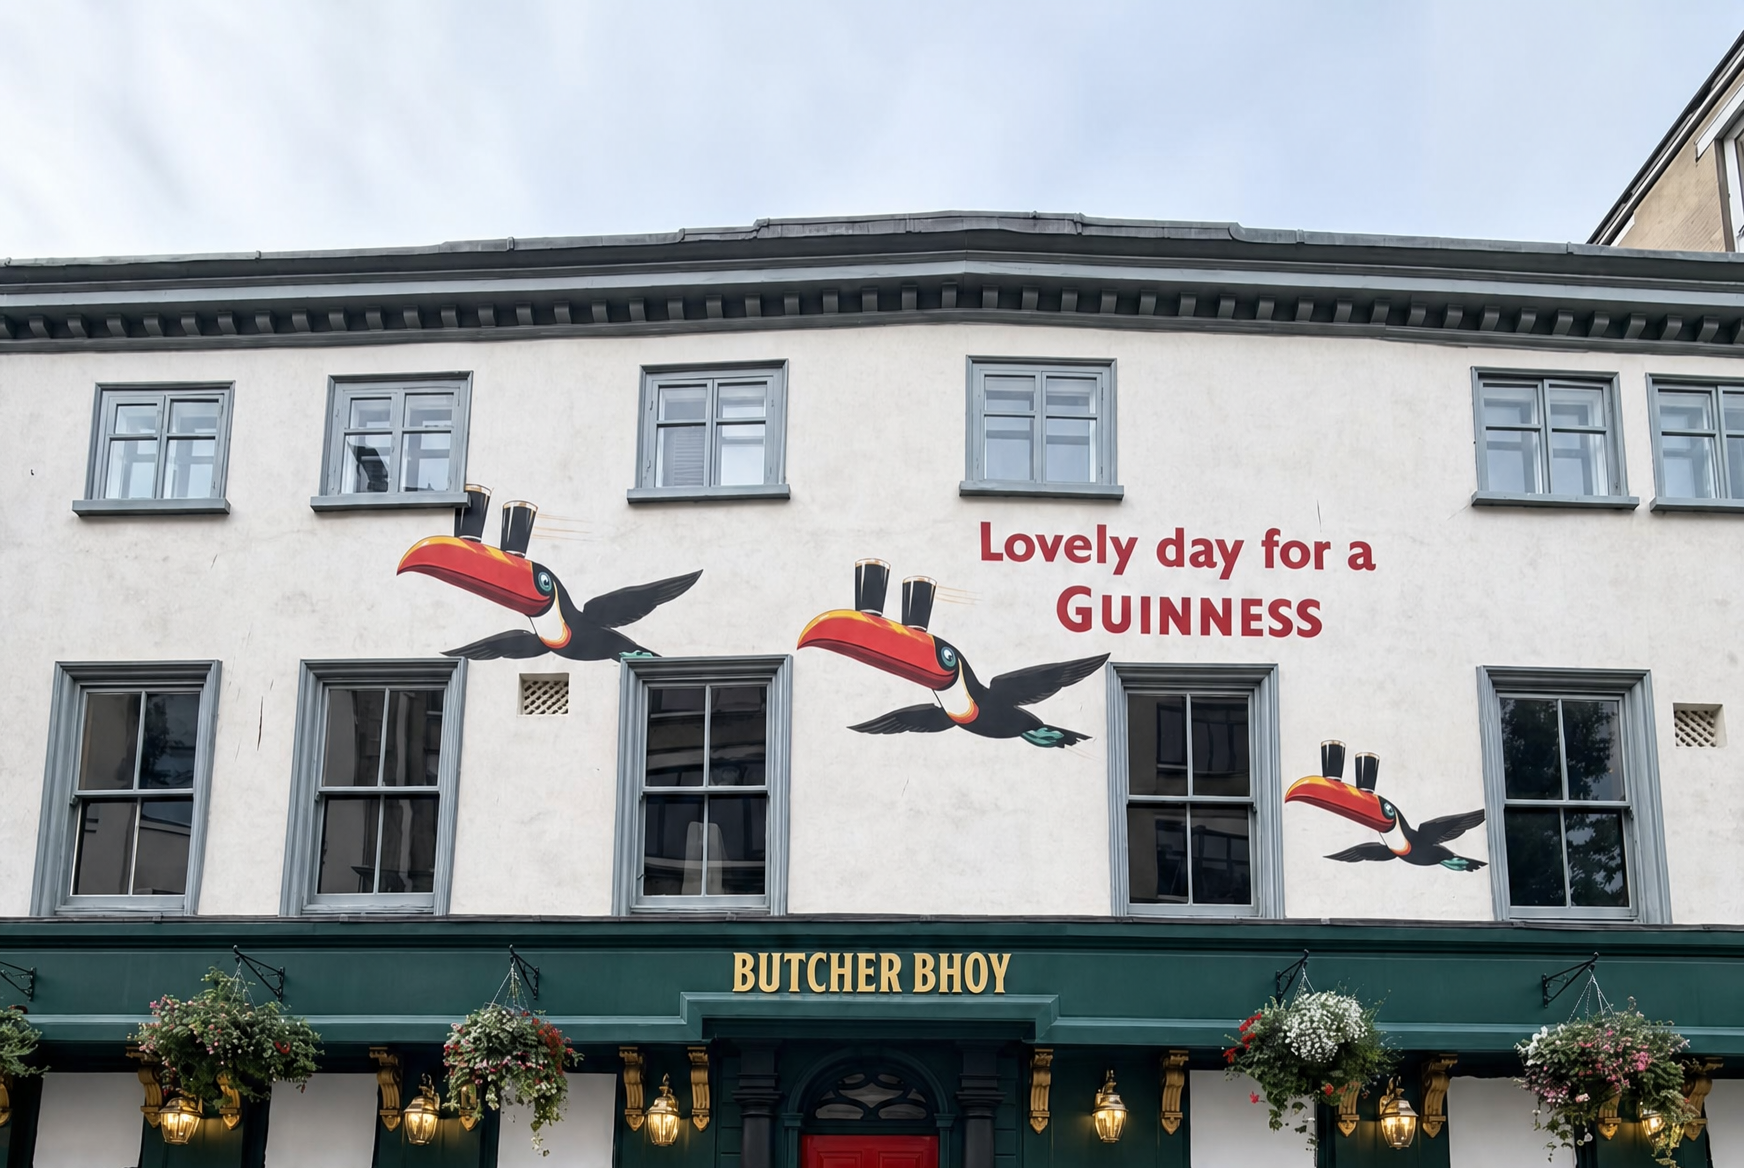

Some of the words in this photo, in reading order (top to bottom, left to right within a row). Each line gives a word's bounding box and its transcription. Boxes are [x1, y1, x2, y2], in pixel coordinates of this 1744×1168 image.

[980, 521, 1139, 576] Lovely
[1155, 527, 1245, 580] day
[1261, 528, 1331, 570] for
[1347, 540, 1377, 571] a
[1056, 585, 1323, 638] GUINNESS
[732, 951, 902, 993] BUTCHER
[912, 951, 1012, 993] BHOY
